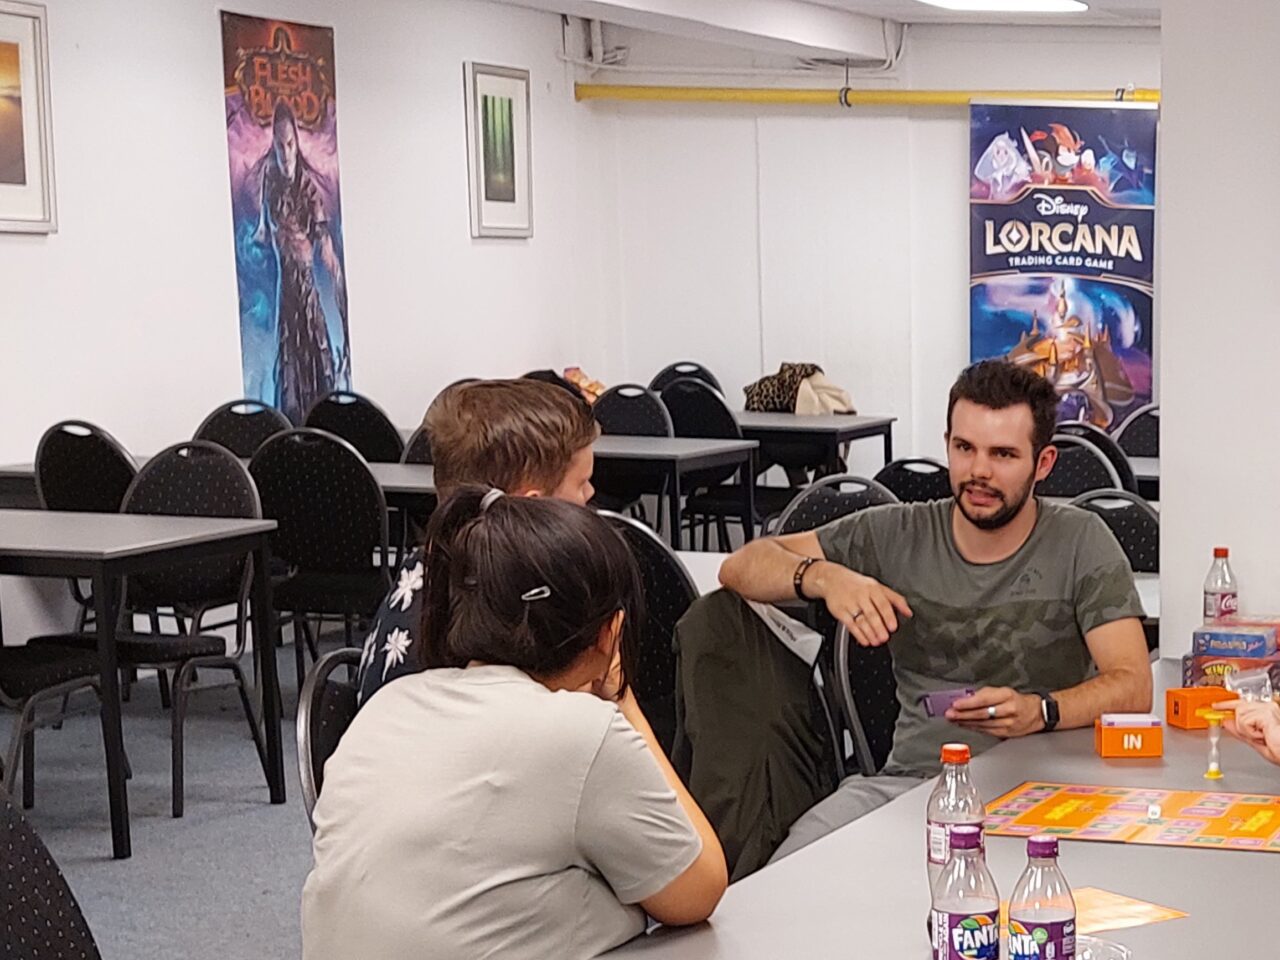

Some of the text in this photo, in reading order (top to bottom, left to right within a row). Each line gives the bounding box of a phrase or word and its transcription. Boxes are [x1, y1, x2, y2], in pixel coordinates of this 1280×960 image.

[253, 56, 313, 92] FLESH
[1033, 193, 1089, 223] Disney
[984, 219, 1144, 262] LORCANA
[1008, 255, 1114, 270] TRADING CARD GAME
[1123, 733, 1142, 750] IN
